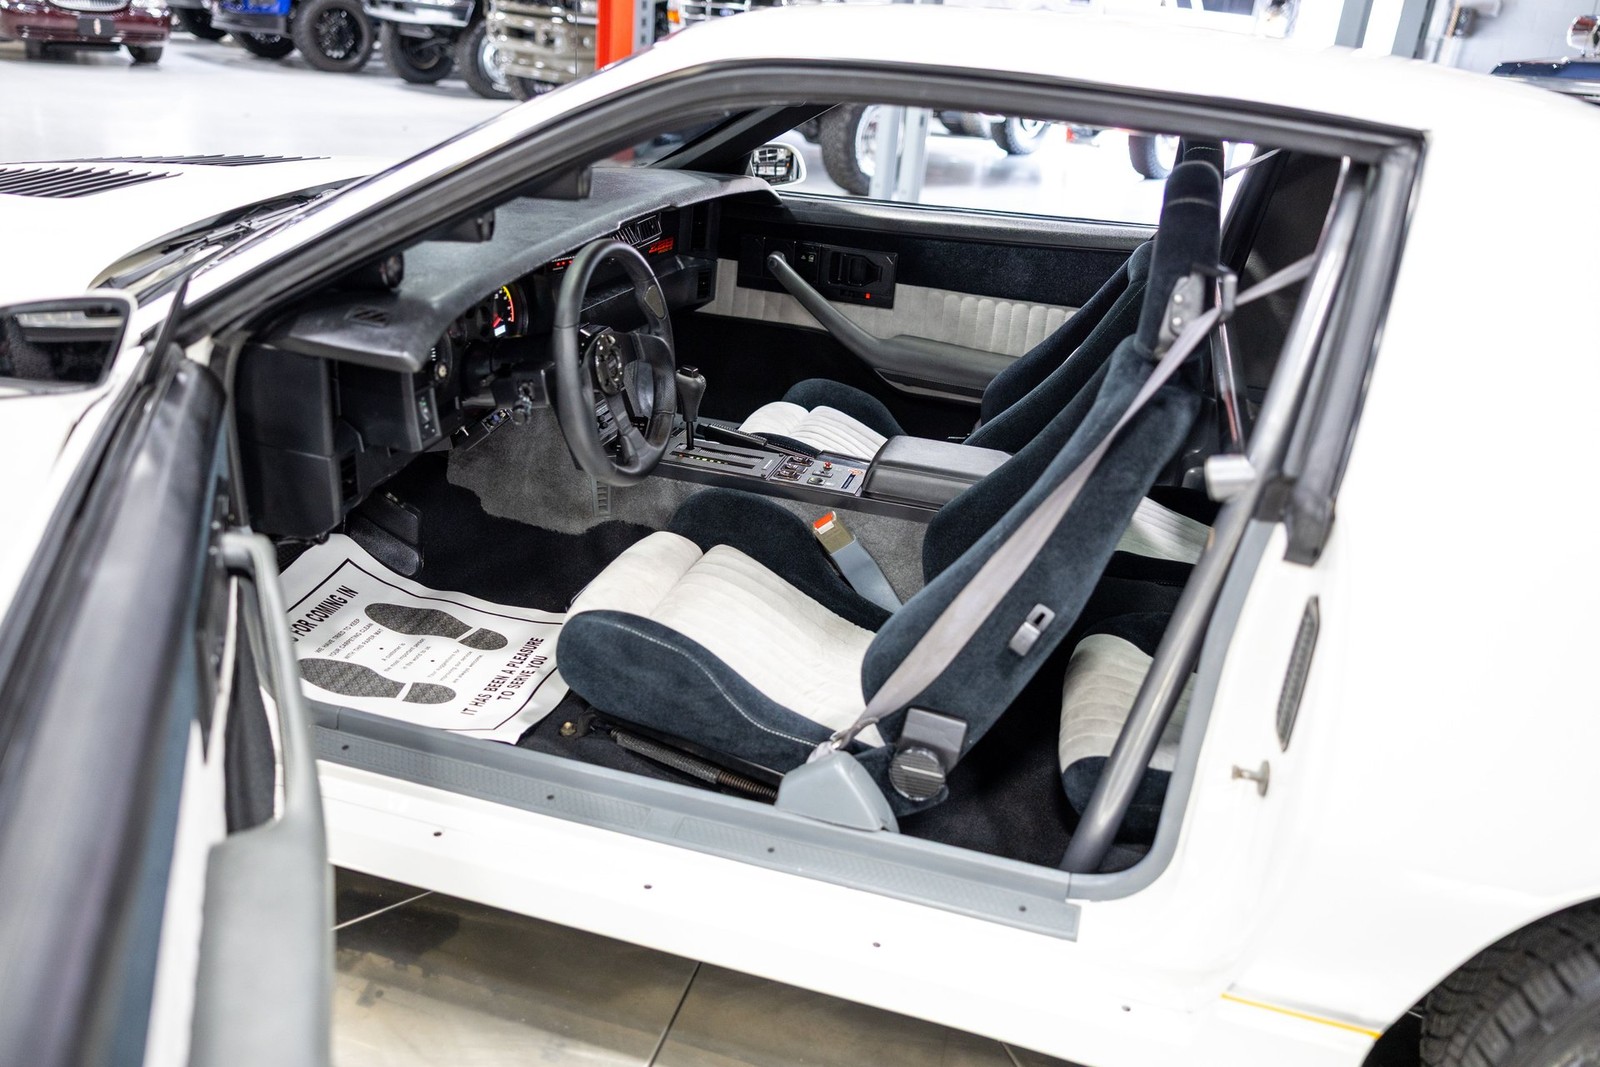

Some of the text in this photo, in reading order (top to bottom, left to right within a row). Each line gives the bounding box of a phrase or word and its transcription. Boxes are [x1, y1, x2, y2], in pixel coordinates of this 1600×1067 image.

[290, 585, 359, 637] FOR COMING IN
[506, 637, 545, 669] PLEASURE
[483, 674, 510, 692] BEEN
[496, 655, 549, 700] TO SERVE YOU
[460, 708, 478, 716] IT
[468, 693, 492, 708] HAS
